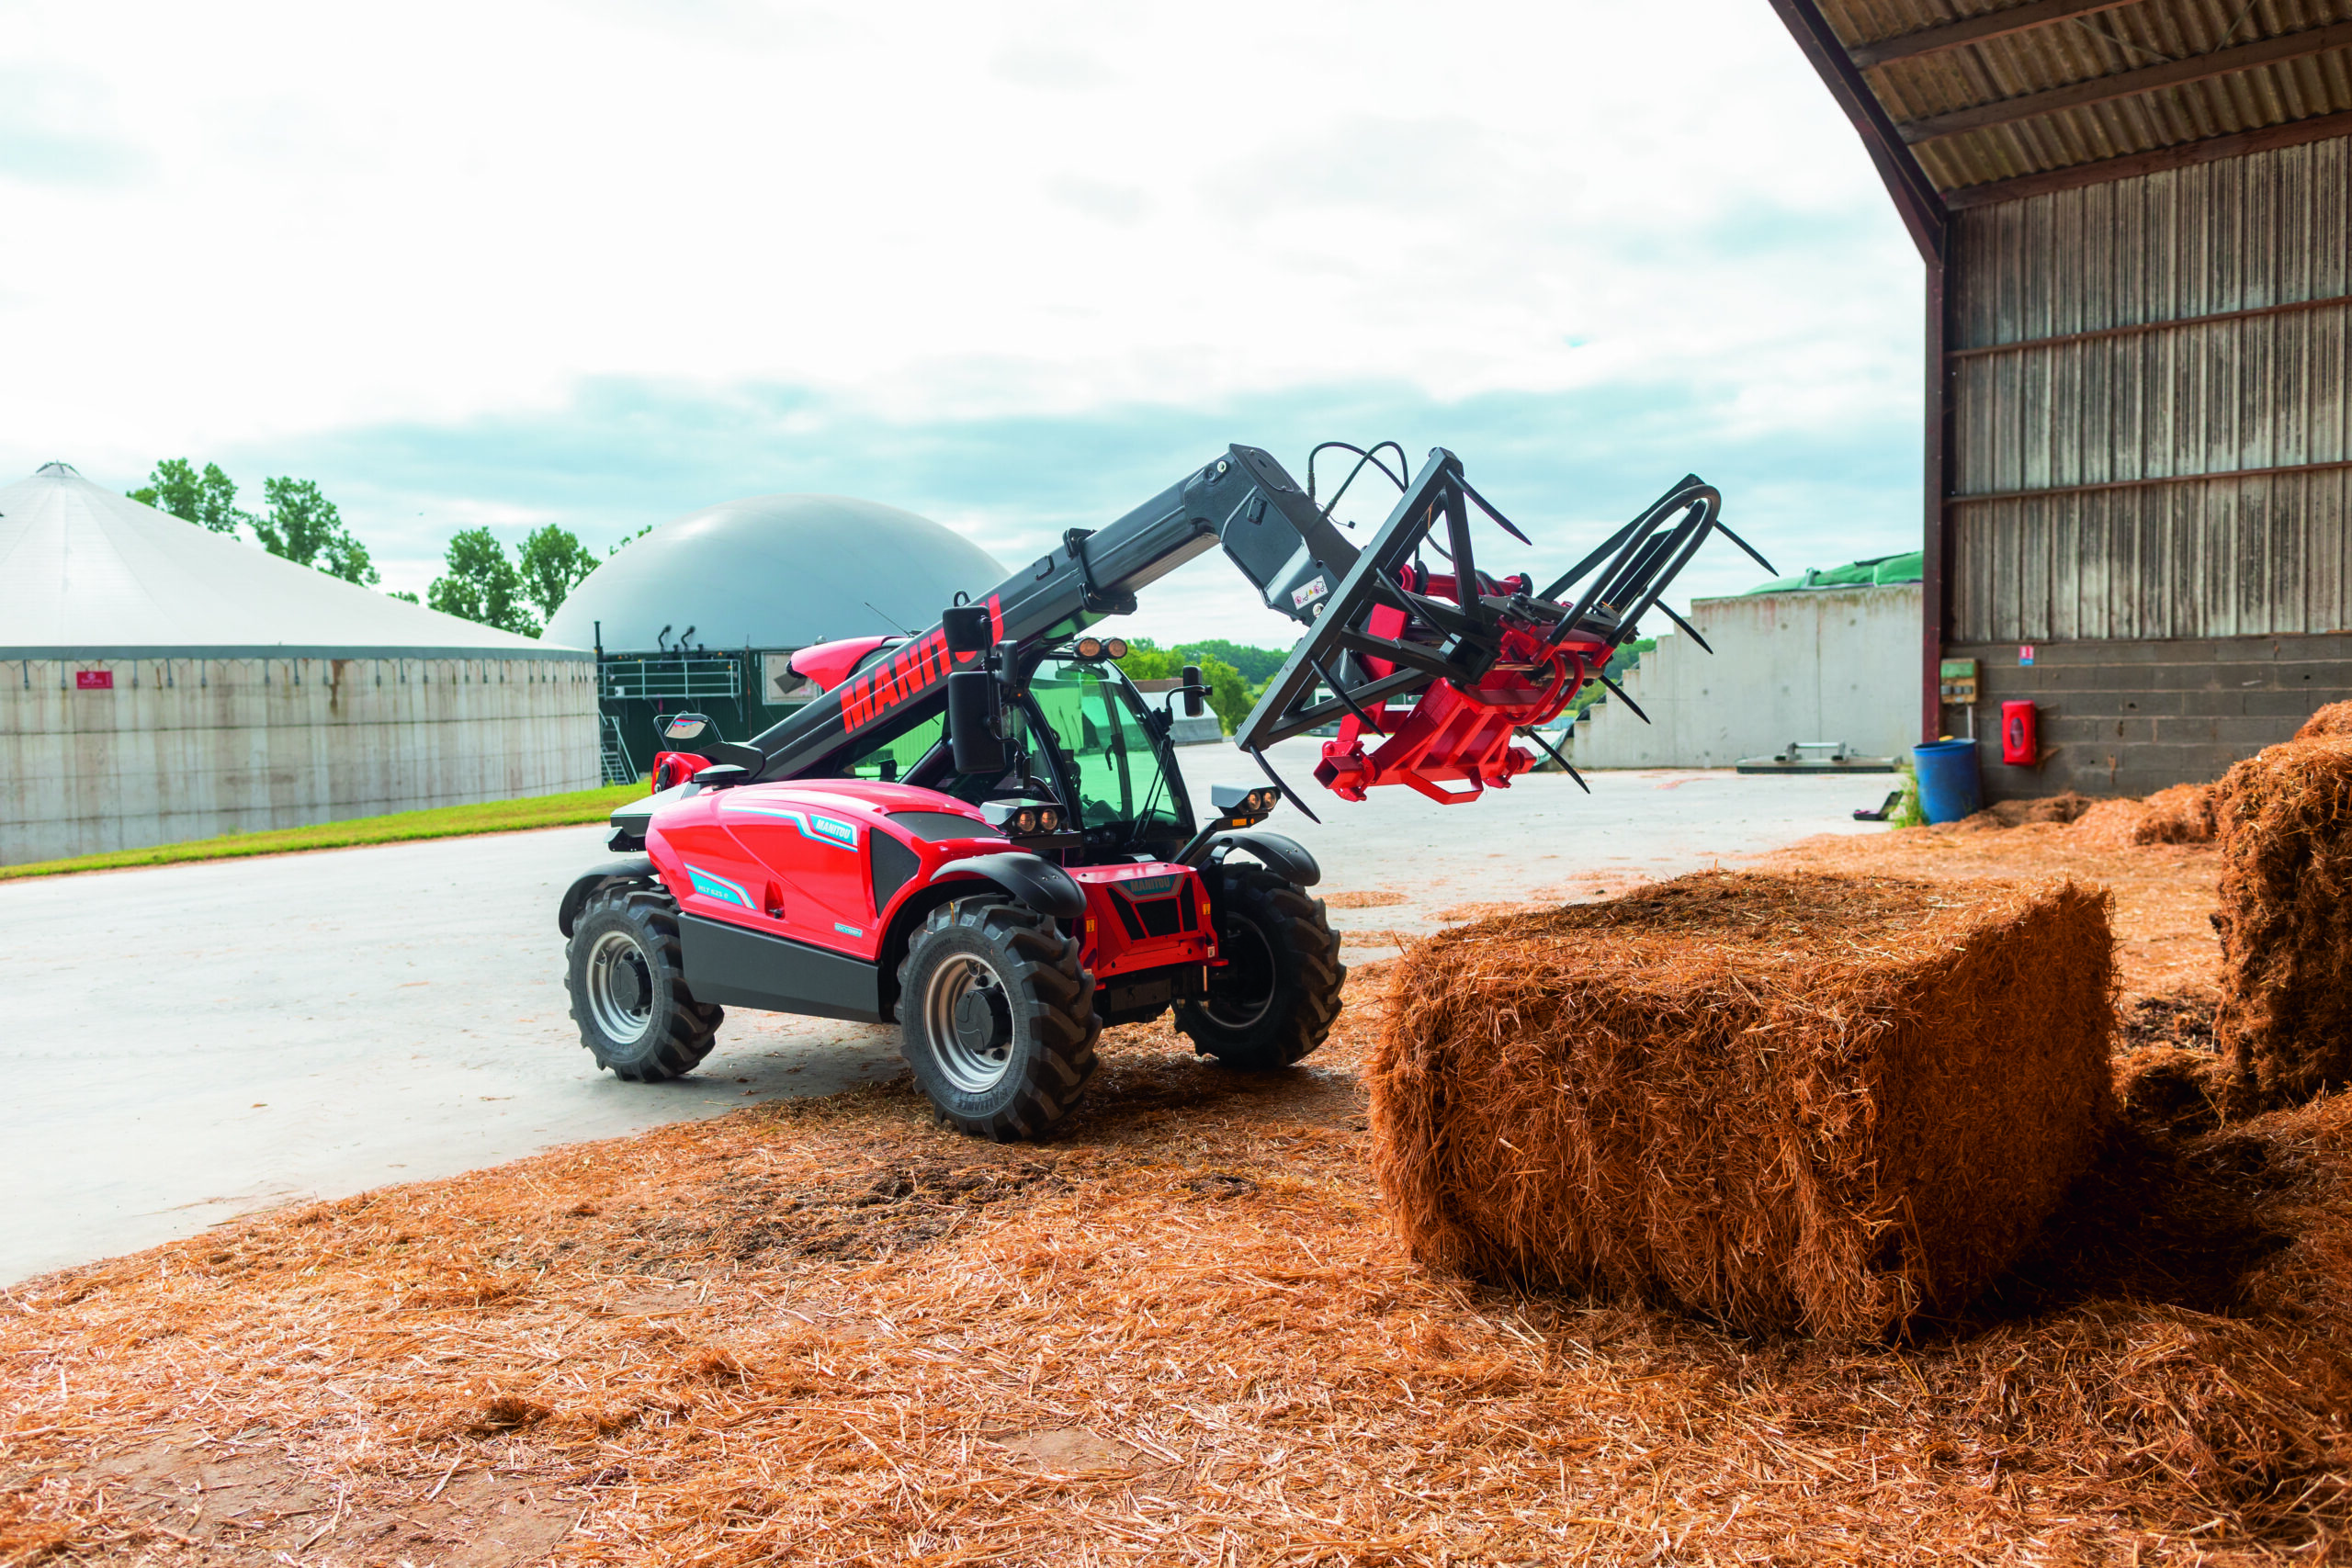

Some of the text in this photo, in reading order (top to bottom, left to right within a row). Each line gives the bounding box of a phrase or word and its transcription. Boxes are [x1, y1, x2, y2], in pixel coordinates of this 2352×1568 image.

[840, 593, 1004, 734] MANITU
[815, 818, 852, 840] MANITOU
[1130, 876, 1170, 892] MANITOU
